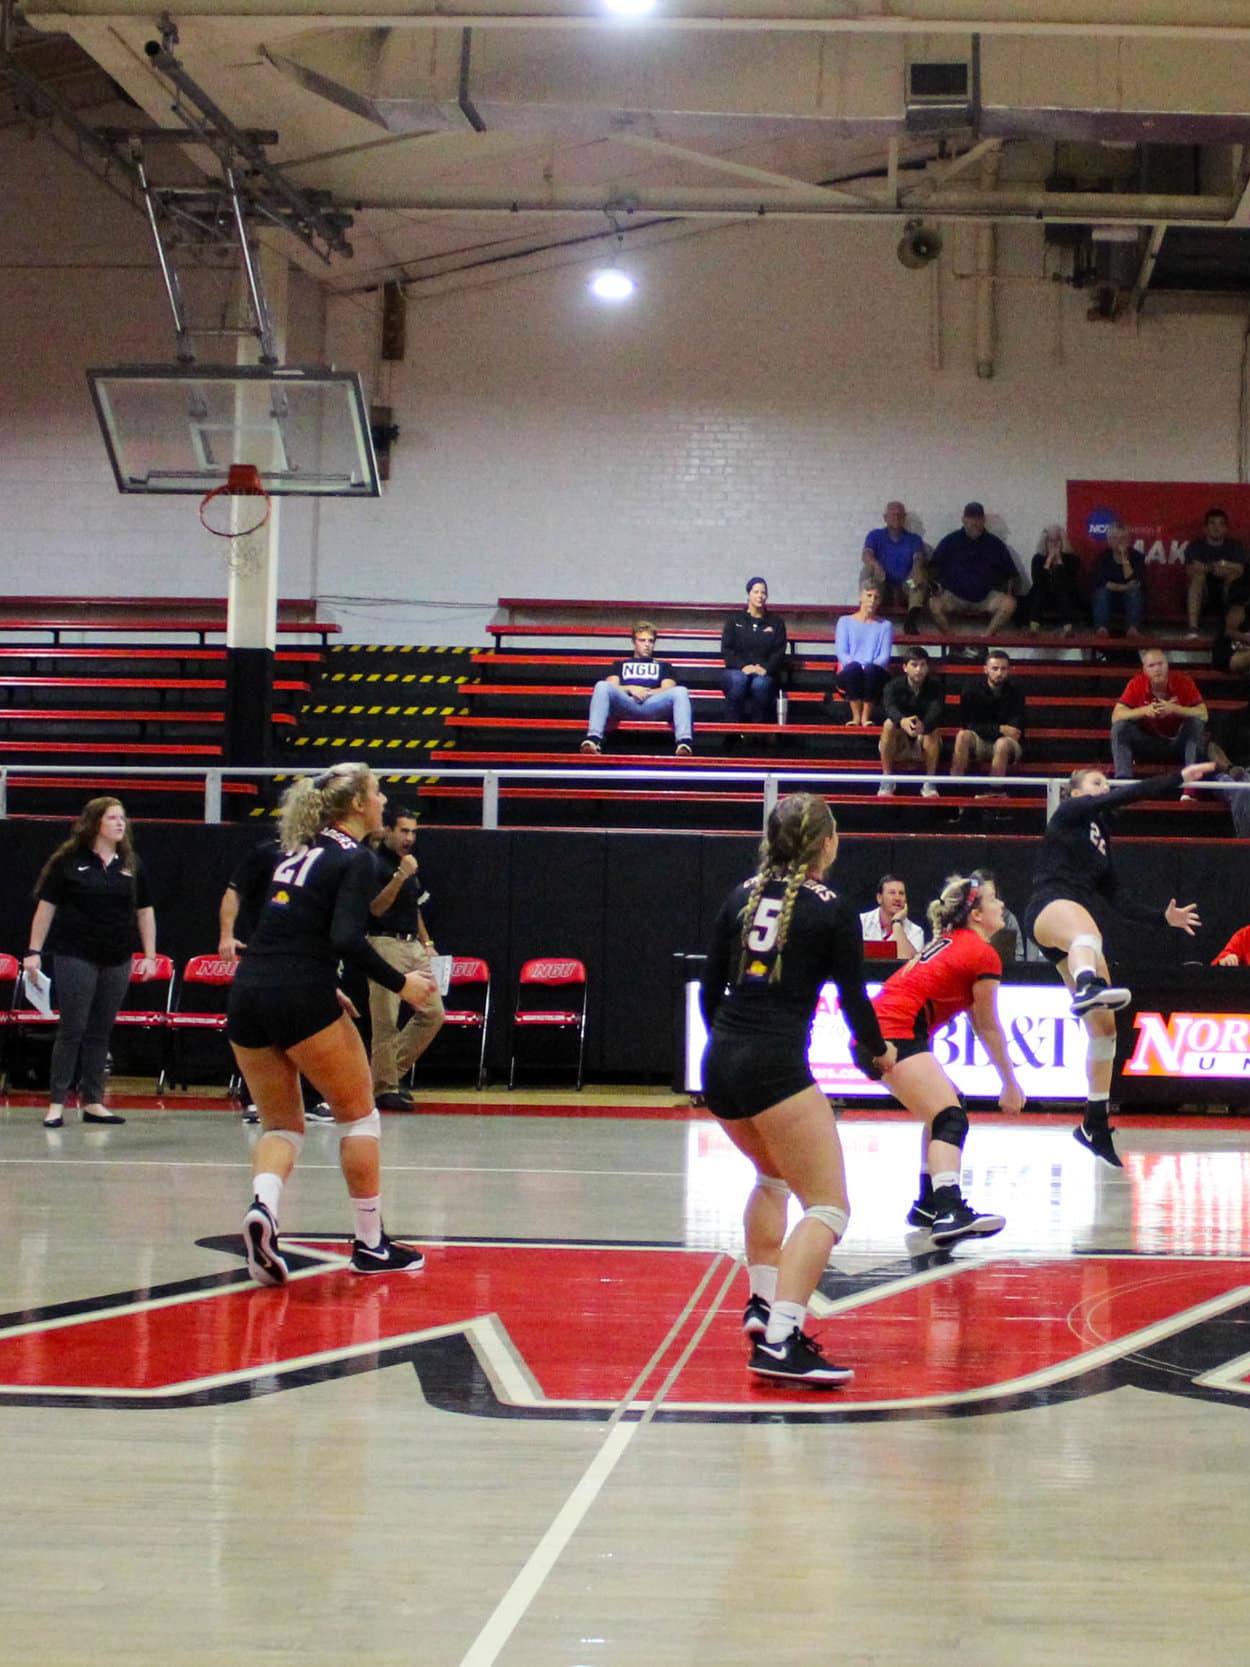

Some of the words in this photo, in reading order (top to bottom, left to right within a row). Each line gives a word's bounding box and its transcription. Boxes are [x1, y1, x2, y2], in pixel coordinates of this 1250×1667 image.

[622, 663, 659, 677] NGU
[272, 848, 325, 888] 21
[747, 896, 785, 952] 5
[530, 962, 577, 979] NGU
